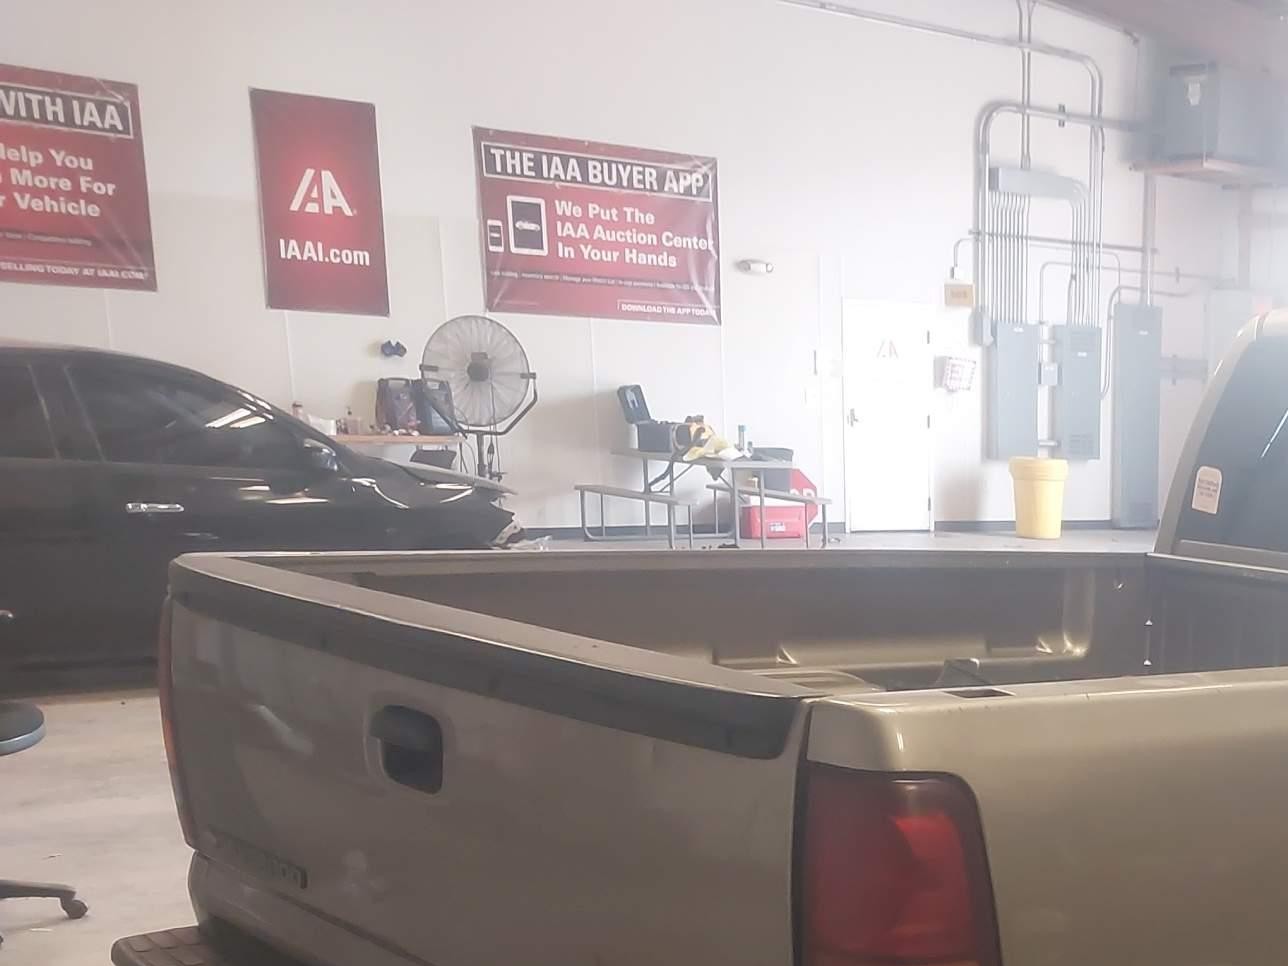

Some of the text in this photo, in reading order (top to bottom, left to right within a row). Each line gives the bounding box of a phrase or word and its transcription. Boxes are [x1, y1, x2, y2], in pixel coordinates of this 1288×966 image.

[72, 99, 124, 131] IAA
[48, 148, 94, 171] You
[490, 147, 704, 195] THE IAA BUYER APP
[10, 167, 72, 191] More
[80, 175, 116, 196] For
[13, 191, 101, 217] Vehicle
[554, 199, 655, 225] We Put The
[556, 221, 713, 250] IAA Auction Center
[279, 238, 370, 266] IAAI.com
[557, 241, 677, 268] In Your Hands
[46, 264, 80, 275] TODAY
[82, 267, 95, 276] AT
[621, 302, 661, 314] DOWNLOAD
[662, 305, 676, 314] THE
[677, 306, 691, 315] APP
